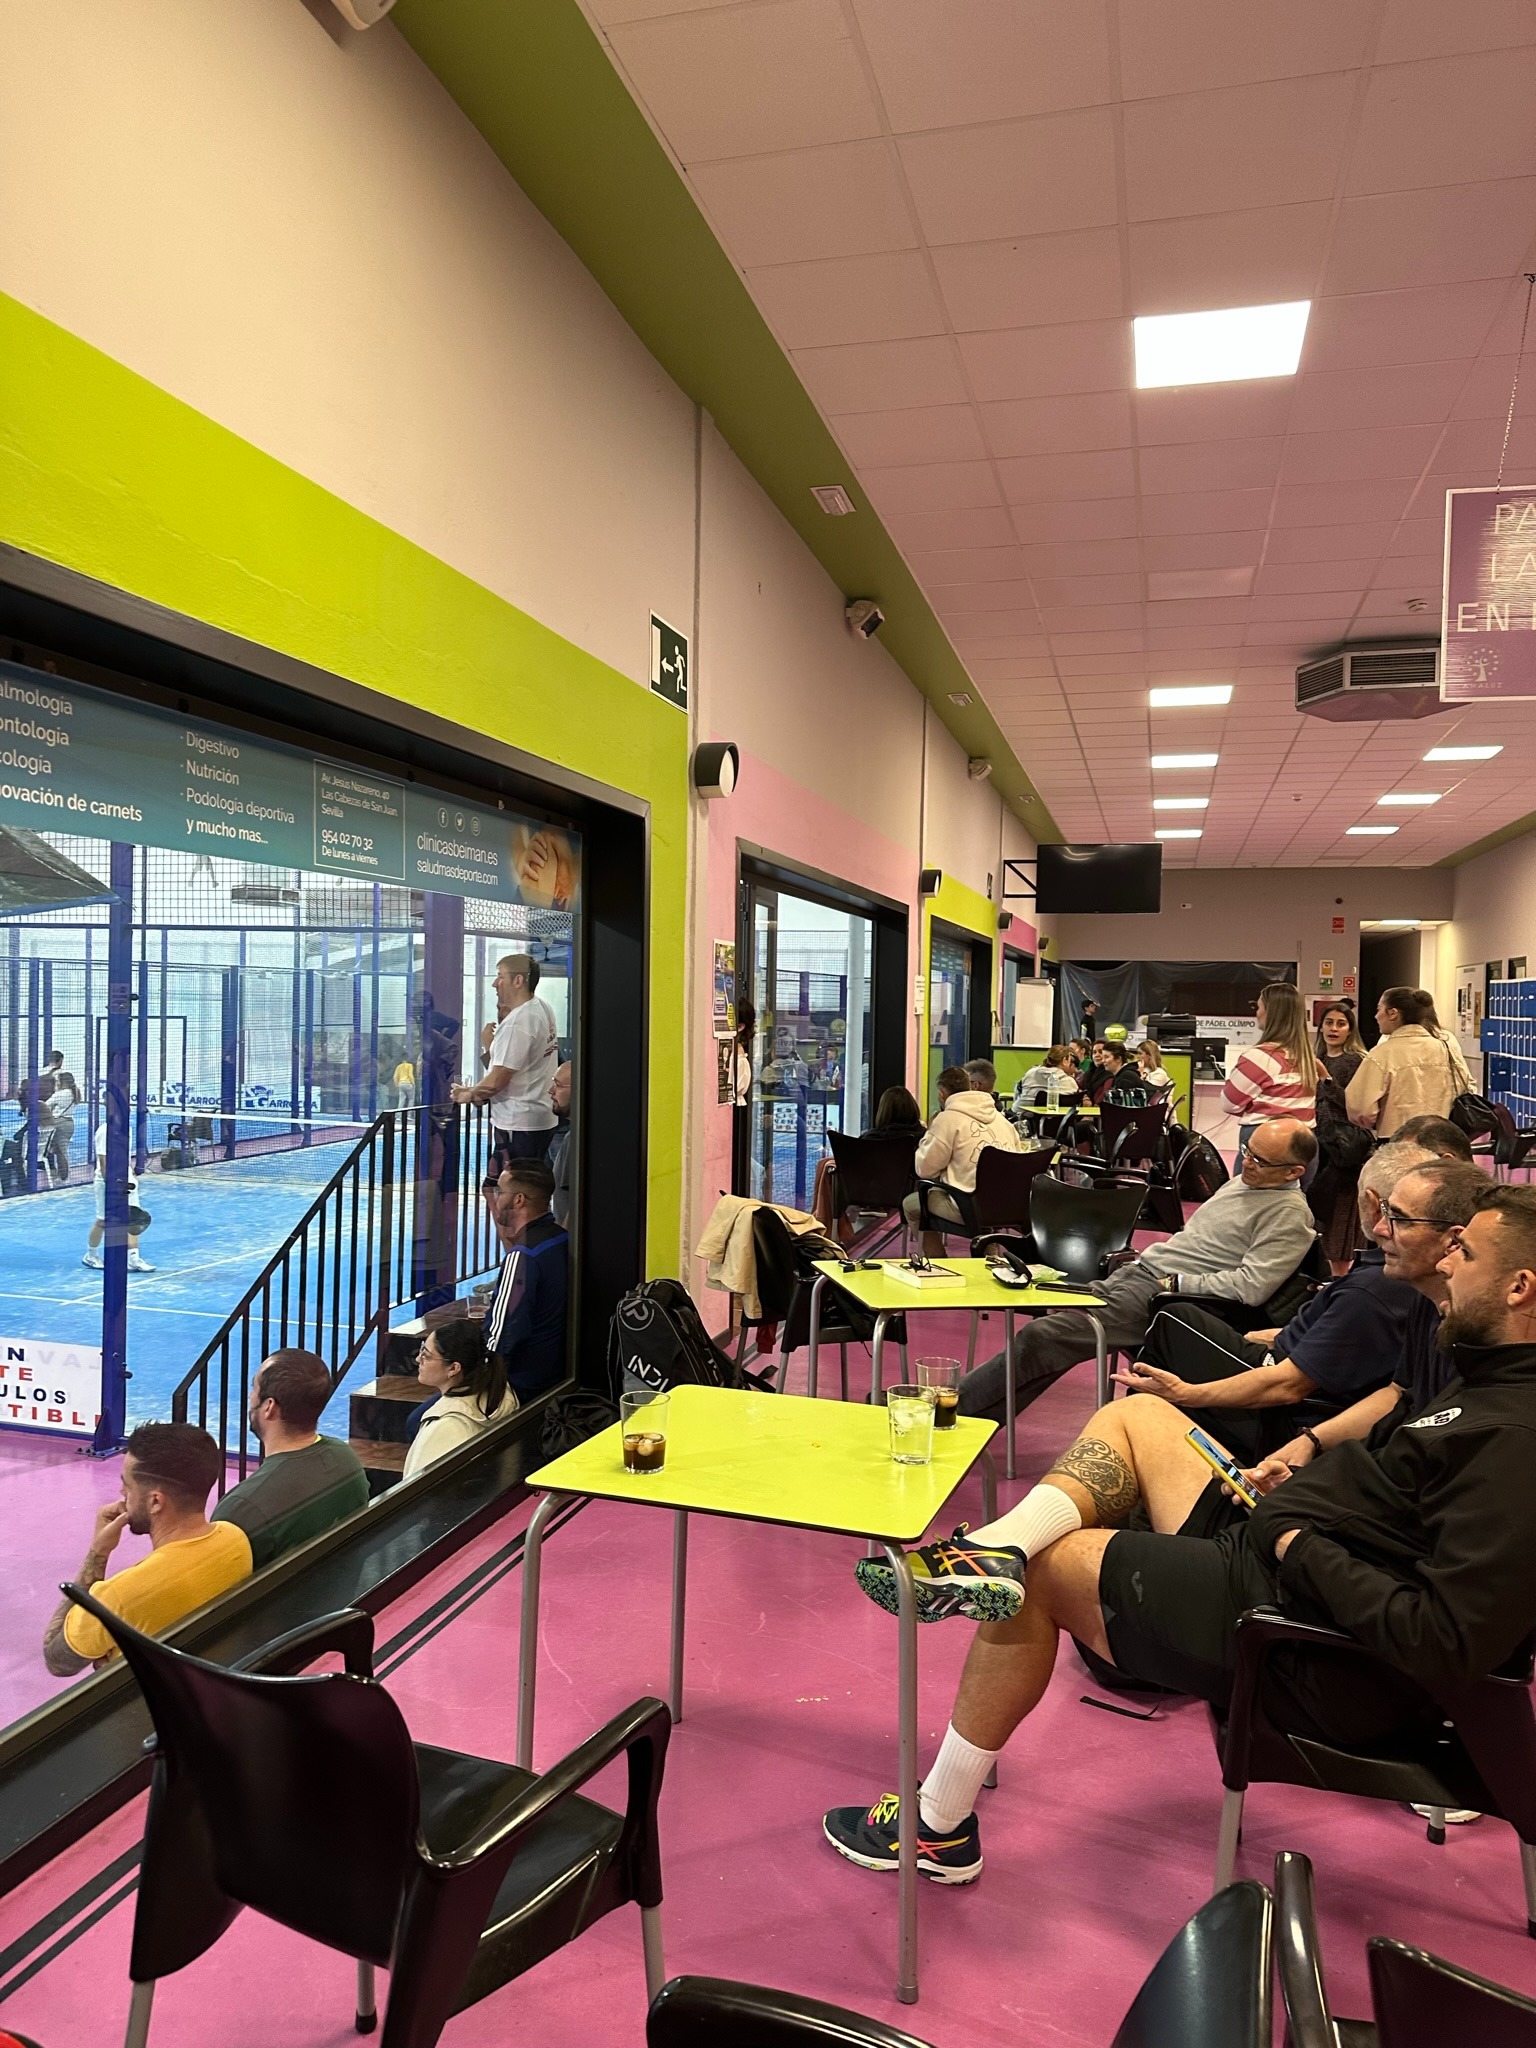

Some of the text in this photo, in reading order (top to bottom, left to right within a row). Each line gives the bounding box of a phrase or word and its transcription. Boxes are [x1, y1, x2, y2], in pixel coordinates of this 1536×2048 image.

[1457, 602, 1510, 632] EN
[186, 731, 240, 759] Digestivo
[0, 749, 52, 775] ología
[186, 759, 240, 786] Nutrición
[0, 784, 143, 822] ovación de carnets
[246, 800, 295, 824] deportiva
[321, 788, 334, 801] Las
[334, 791, 361, 808] Cabezas
[362, 799, 370, 810] de
[371, 801, 383, 813] San
[321, 803, 344, 818] Sevilla
[186, 818, 194, 835] y
[196, 820, 237, 839] mucho
[321, 829, 374, 851] 954 02 70 32
[321, 845, 378, 866] De lunes a viernes
[417, 858, 499, 886] saludmasdeporte.com
